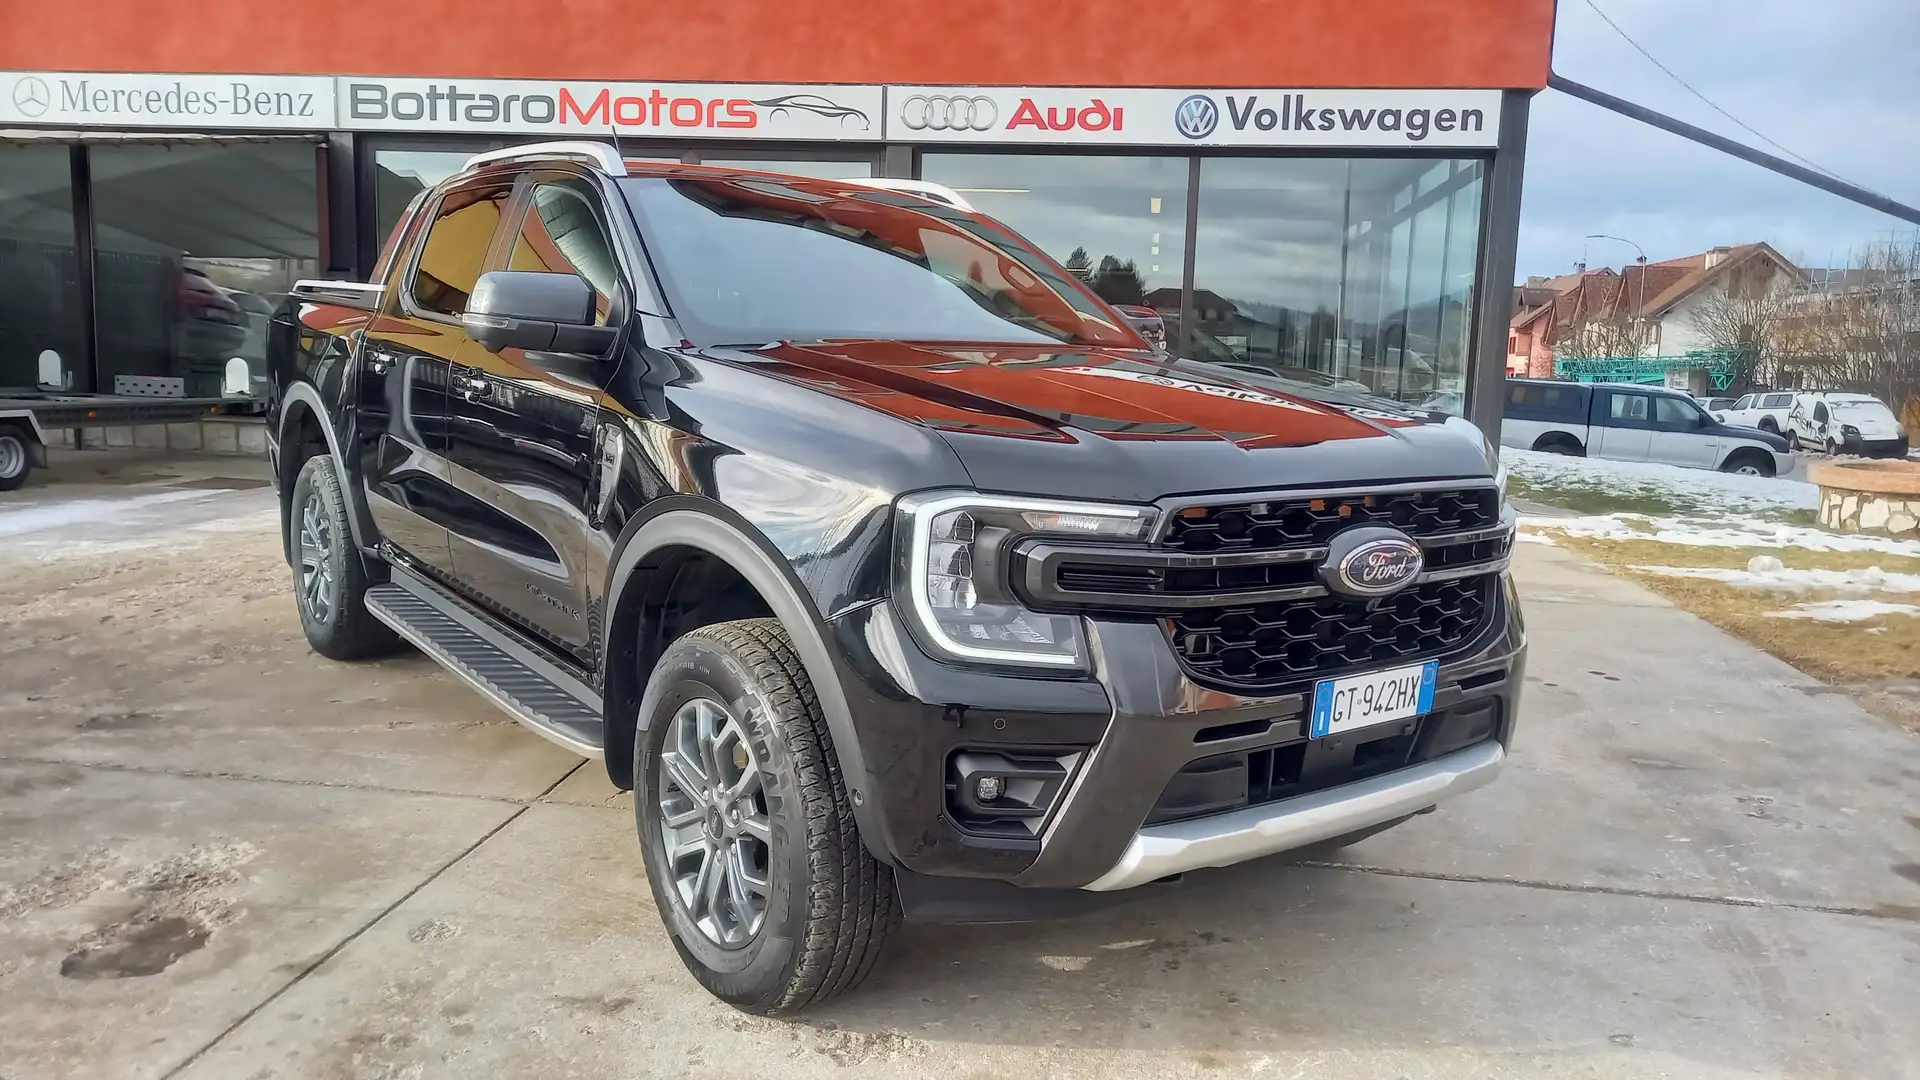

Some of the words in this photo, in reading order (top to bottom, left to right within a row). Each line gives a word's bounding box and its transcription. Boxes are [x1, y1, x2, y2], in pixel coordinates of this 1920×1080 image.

[59, 79, 315, 118] Mercedes-Benz
[349, 83, 758, 128] BottaroMotors
[1004, 98, 1124, 132] Audi
[1224, 95, 1485, 141] Volkswagen
[1362, 551, 1407, 581] Ford
